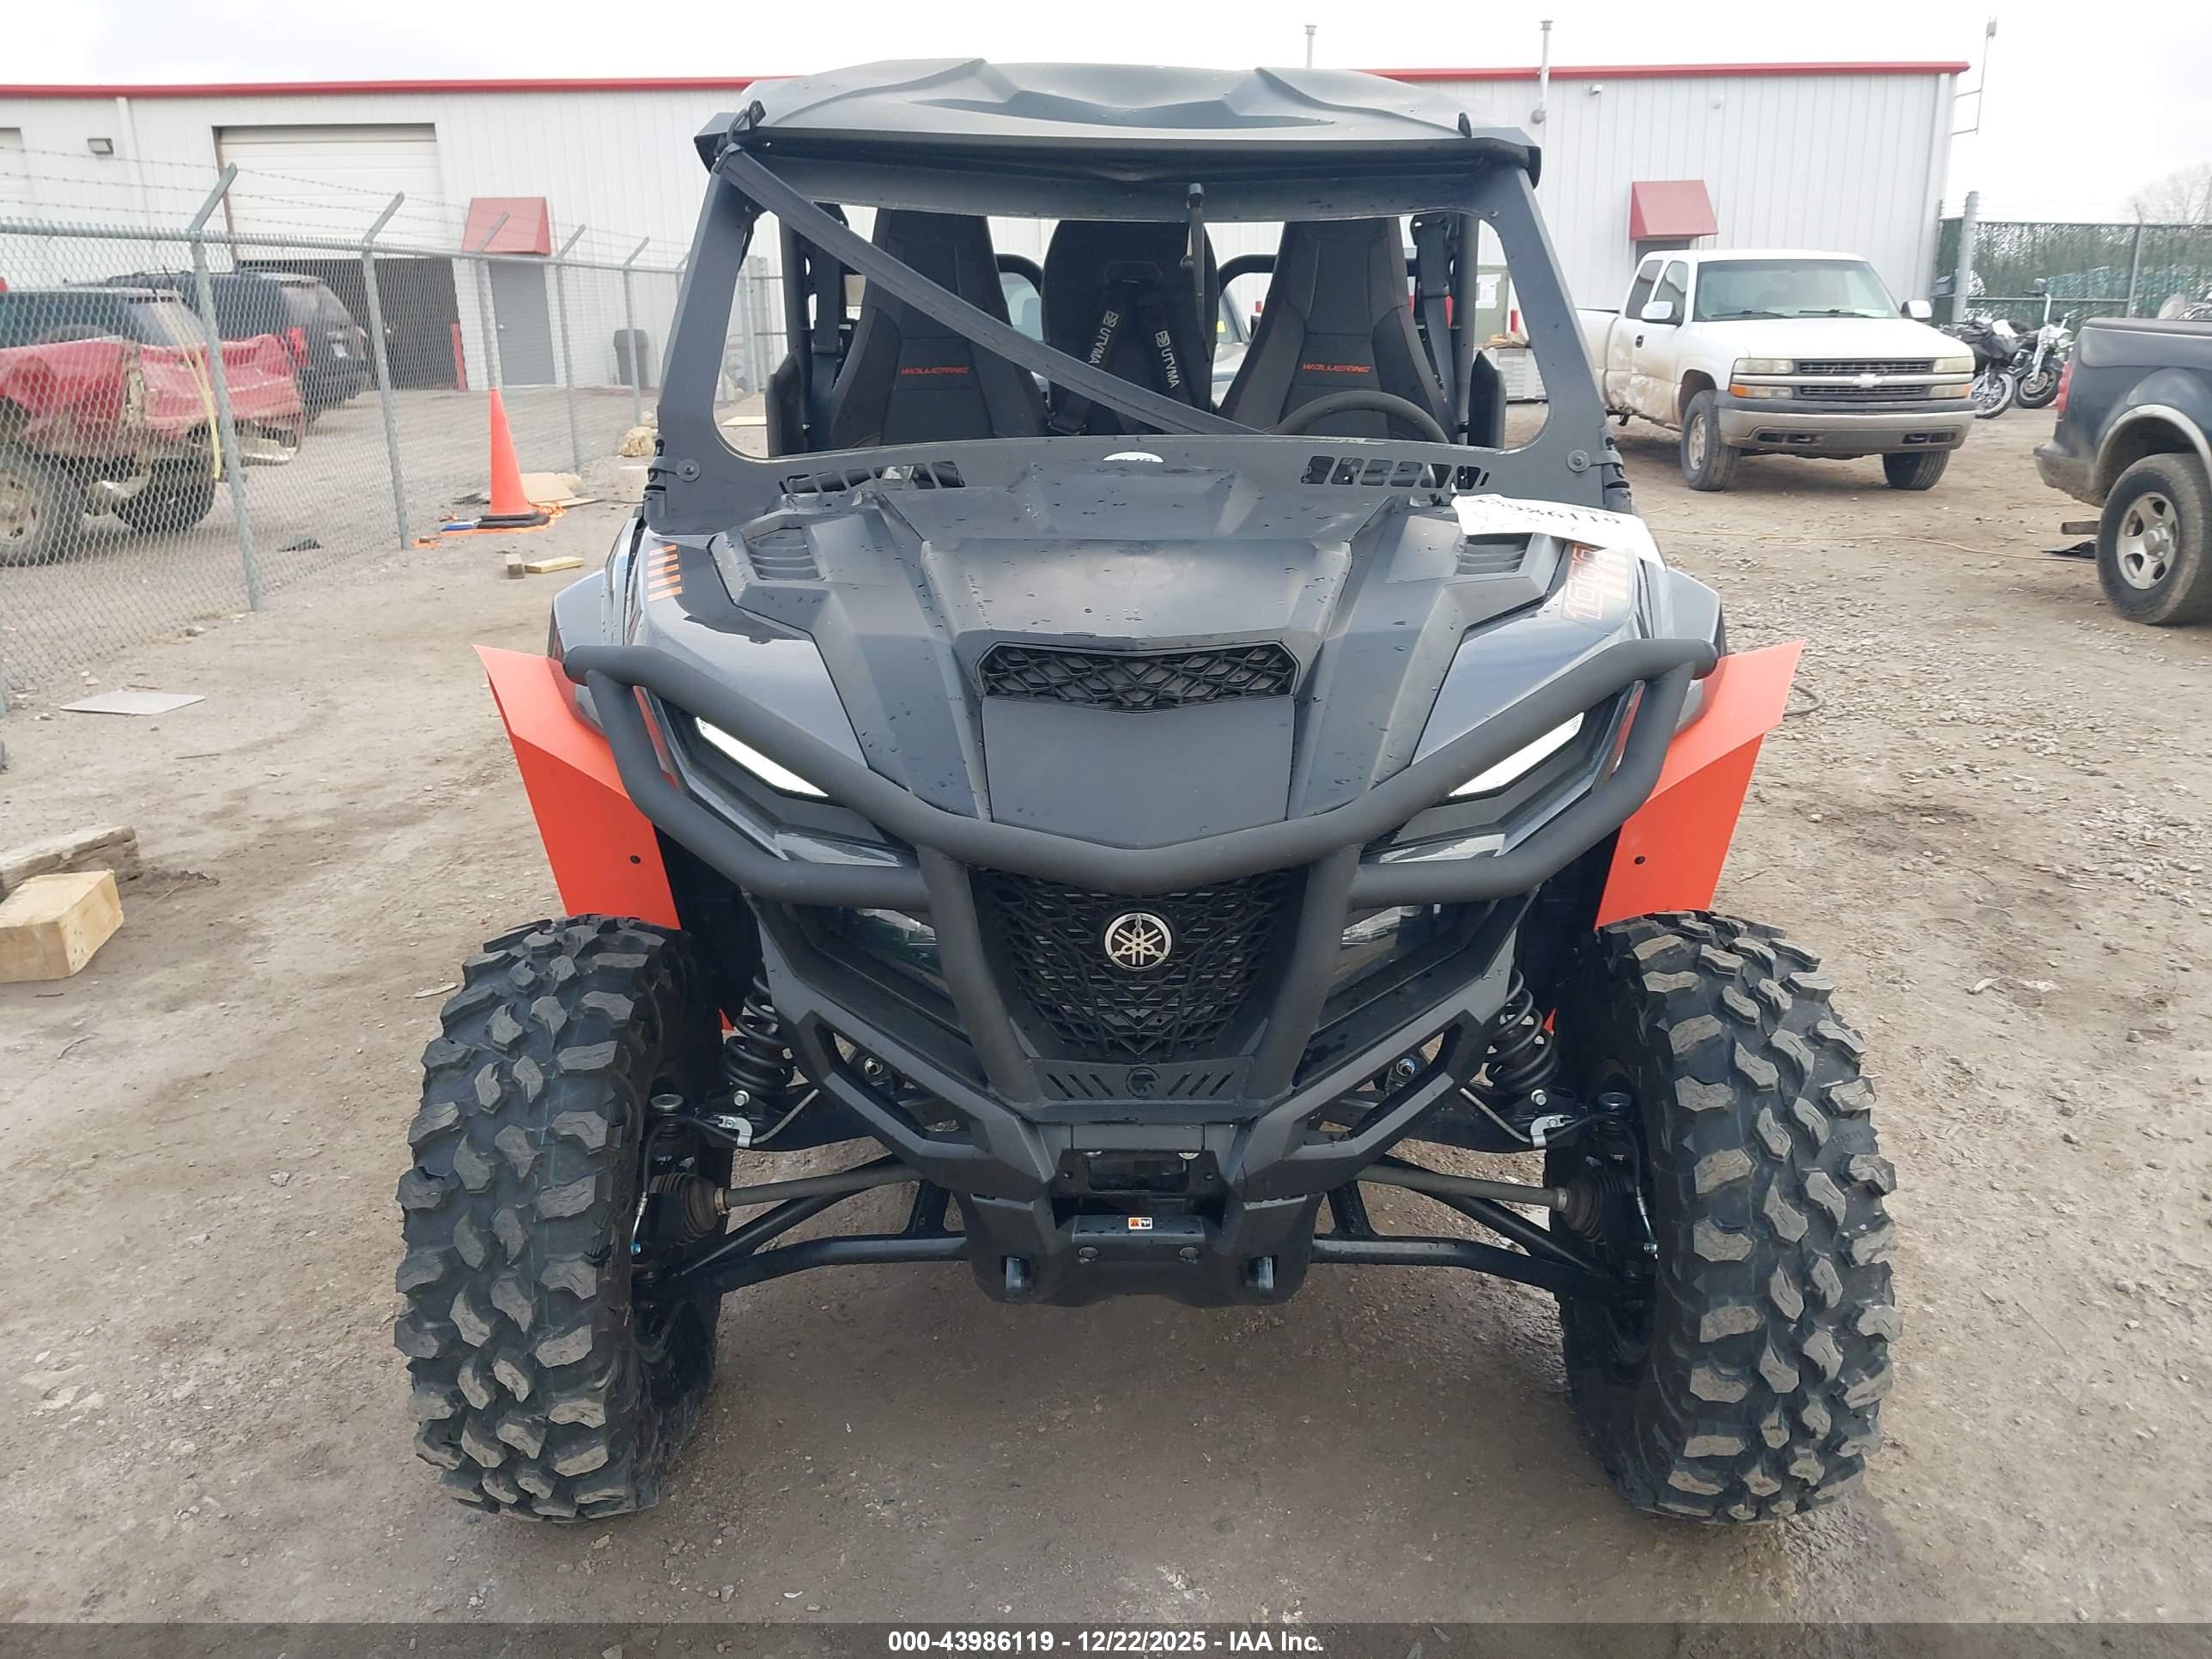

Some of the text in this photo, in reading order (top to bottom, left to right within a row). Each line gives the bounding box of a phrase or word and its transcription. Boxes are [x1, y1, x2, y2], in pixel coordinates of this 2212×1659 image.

[1088, 327, 1112, 364] UTVMA
[1161, 348, 1181, 389] UTVMA
[1302, 363, 1372, 373] WOLVERINE
